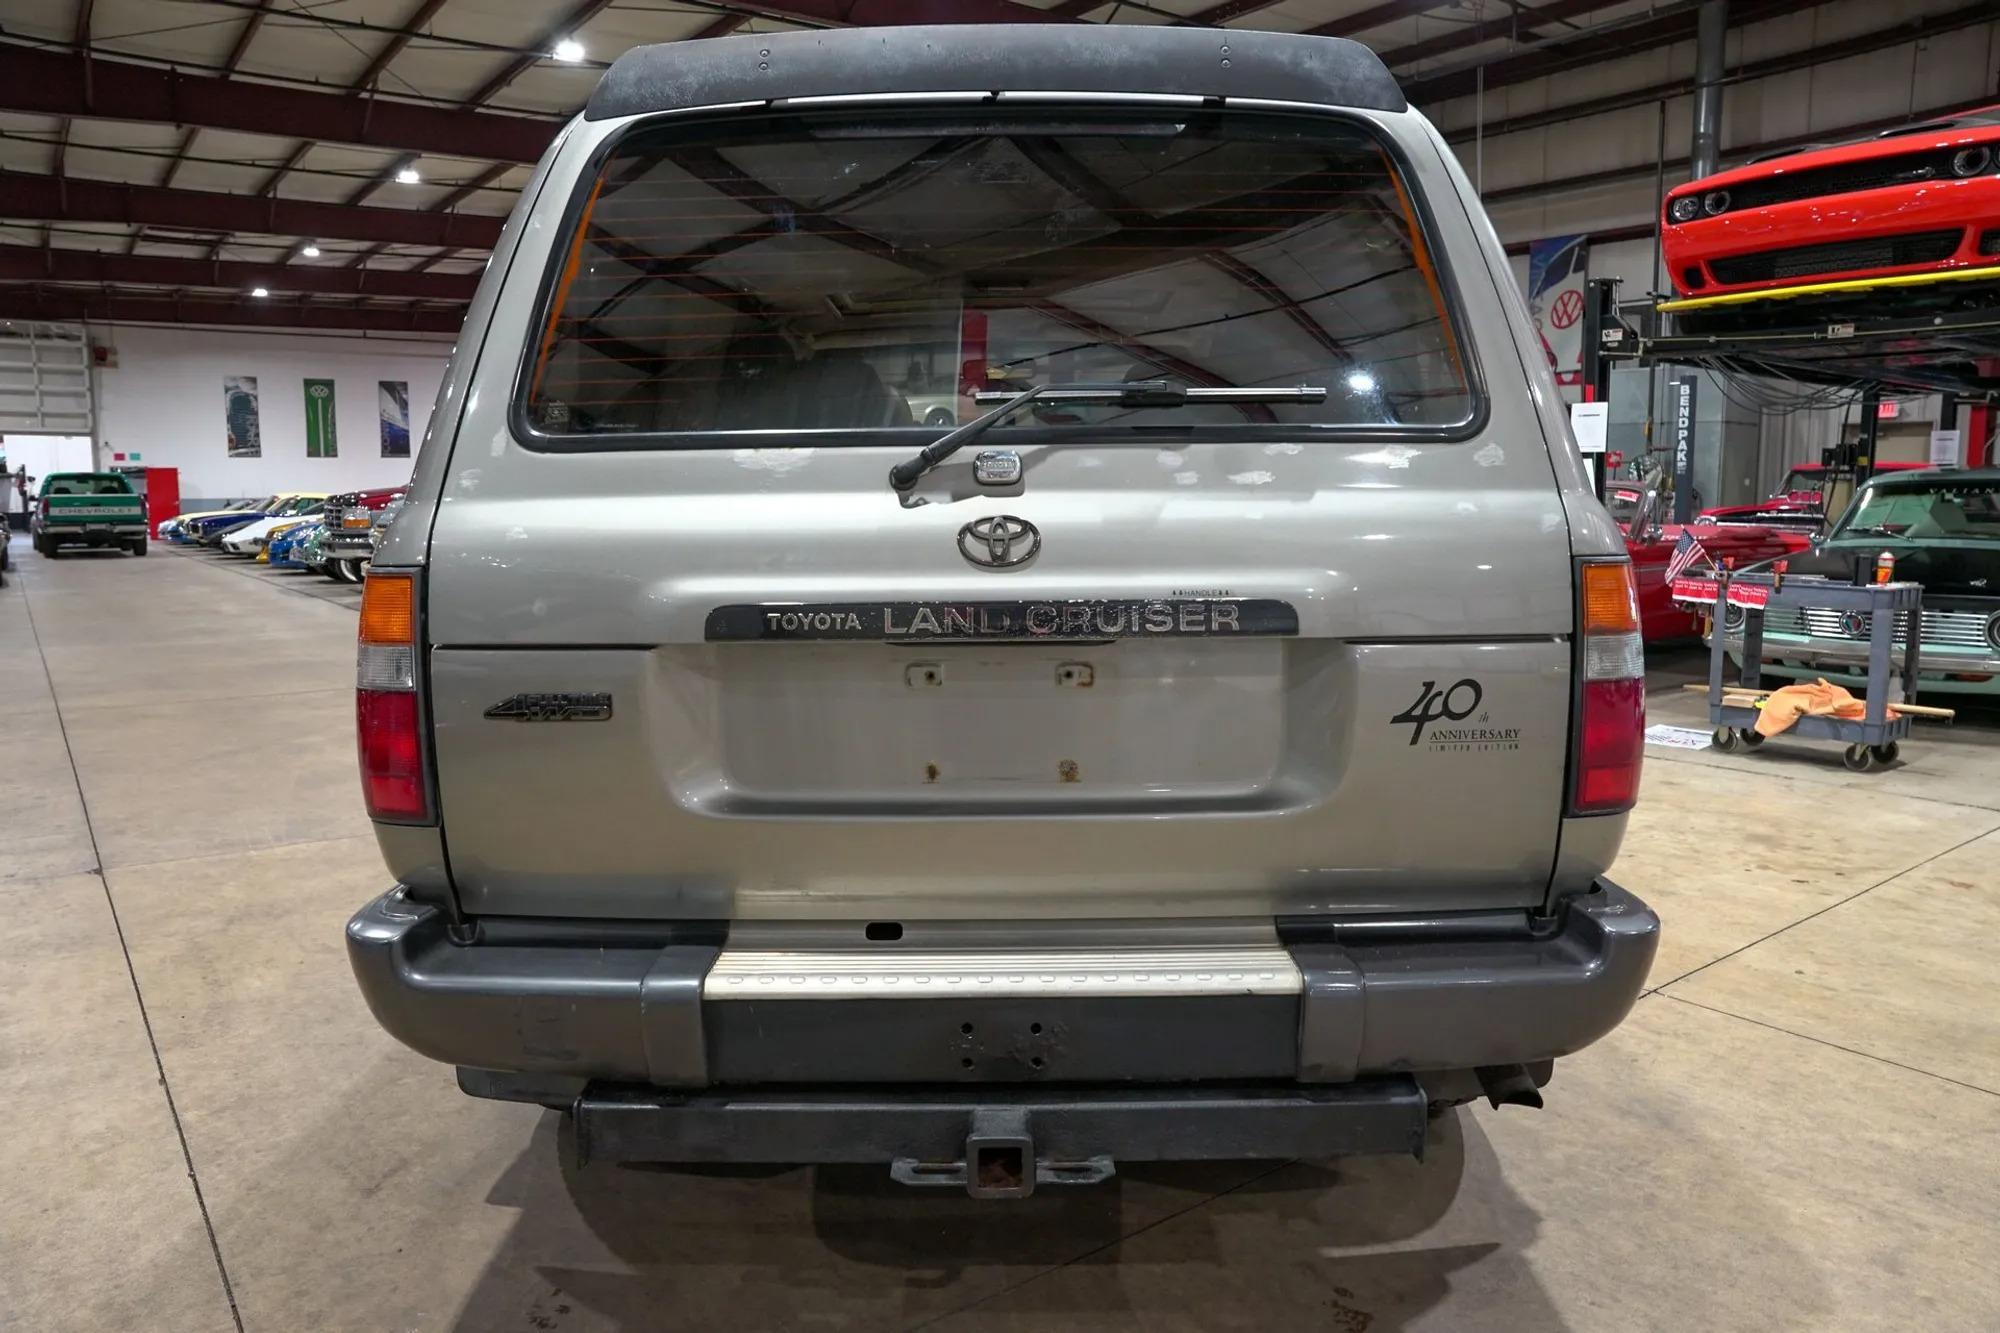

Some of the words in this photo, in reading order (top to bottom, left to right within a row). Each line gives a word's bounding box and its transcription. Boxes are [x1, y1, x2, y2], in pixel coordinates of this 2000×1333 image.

[1676, 384, 1690, 461] BENDPAK
[1184, 589, 1217, 597] HANDLE
[766, 612, 862, 631] TOYOTA
[884, 607, 1010, 634] LAND
[1026, 604, 1240, 634] CRUISER
[1389, 678, 1483, 746] 40
[1429, 729, 1521, 741] ANNIVERSARY
